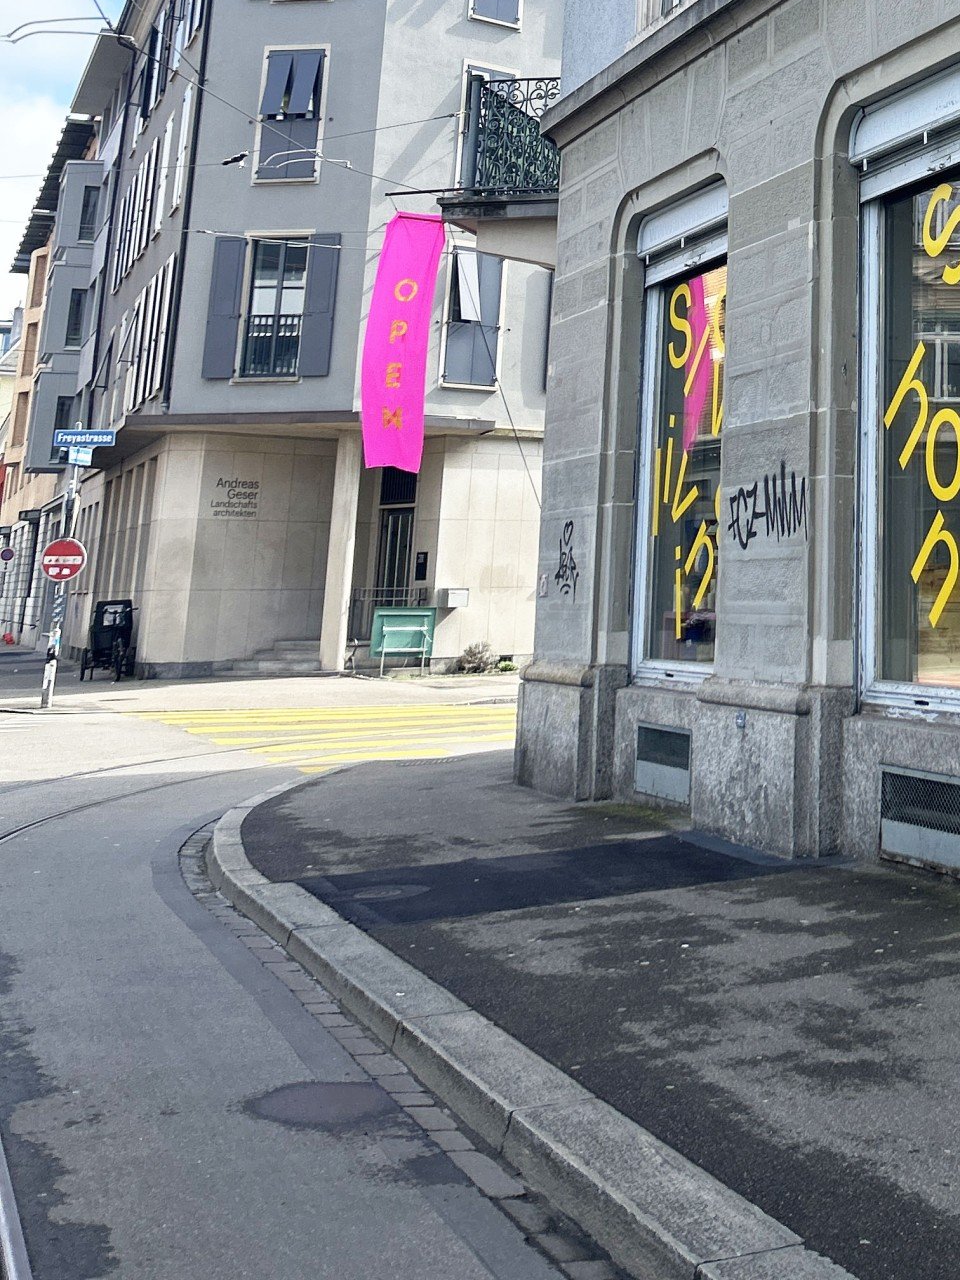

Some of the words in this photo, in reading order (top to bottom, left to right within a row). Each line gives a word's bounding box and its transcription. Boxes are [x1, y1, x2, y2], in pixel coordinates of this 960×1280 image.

[382, 278, 418, 430] OPEN
[57, 432, 113, 444] Freyastrasse
[216, 477, 260, 489] Andreas
[227, 488, 258, 500] Geser
[210, 499, 258, 509] Landschafts
[213, 508, 257, 518] architekten
